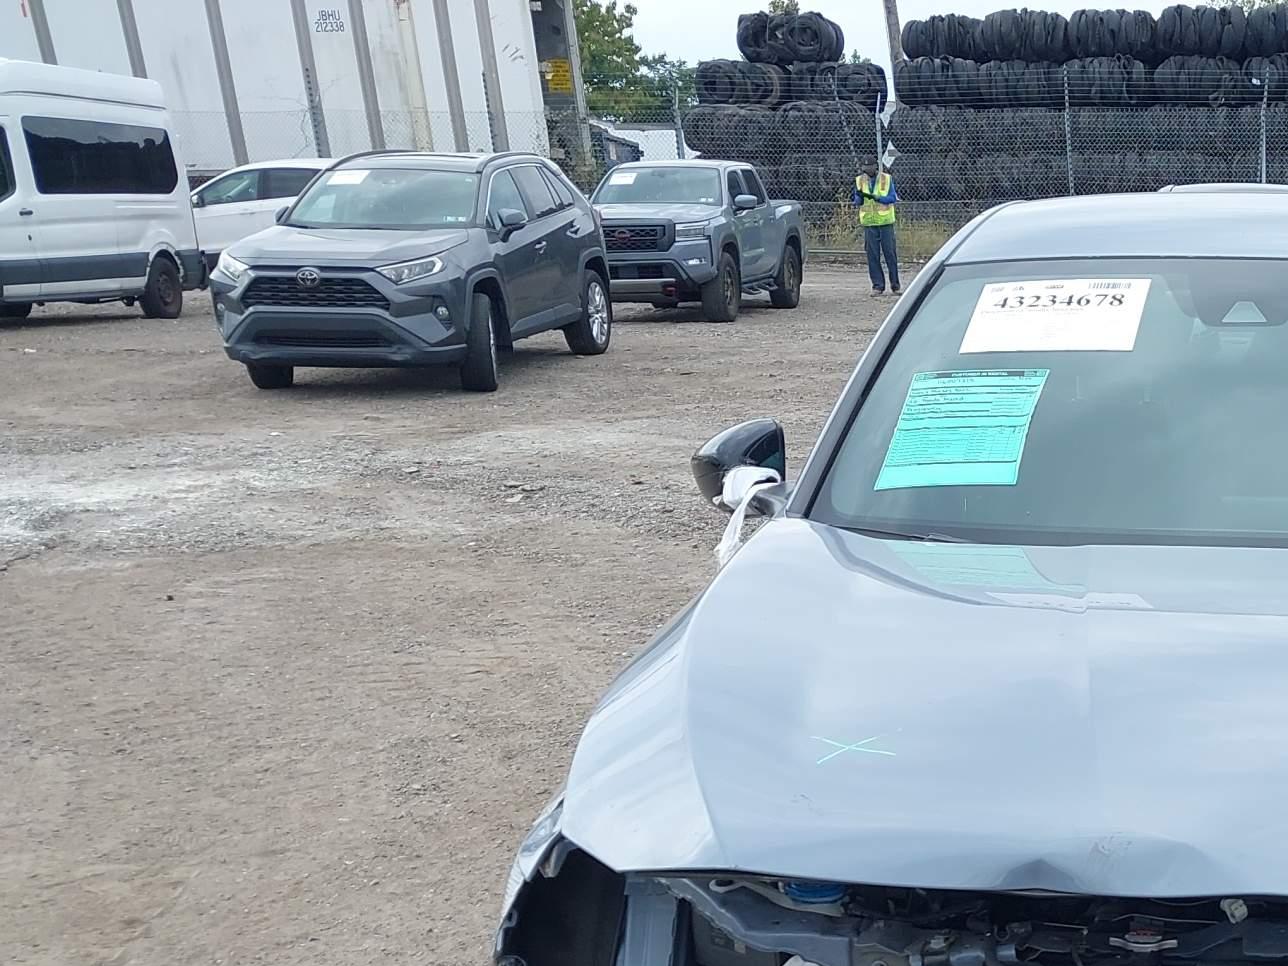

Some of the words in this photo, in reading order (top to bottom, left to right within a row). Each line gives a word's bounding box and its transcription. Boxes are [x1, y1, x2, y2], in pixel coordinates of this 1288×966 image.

[316, 10, 341, 21] JBHU
[315, 21, 345, 32] 212338
[993, 294, 1125, 309] 43234678
